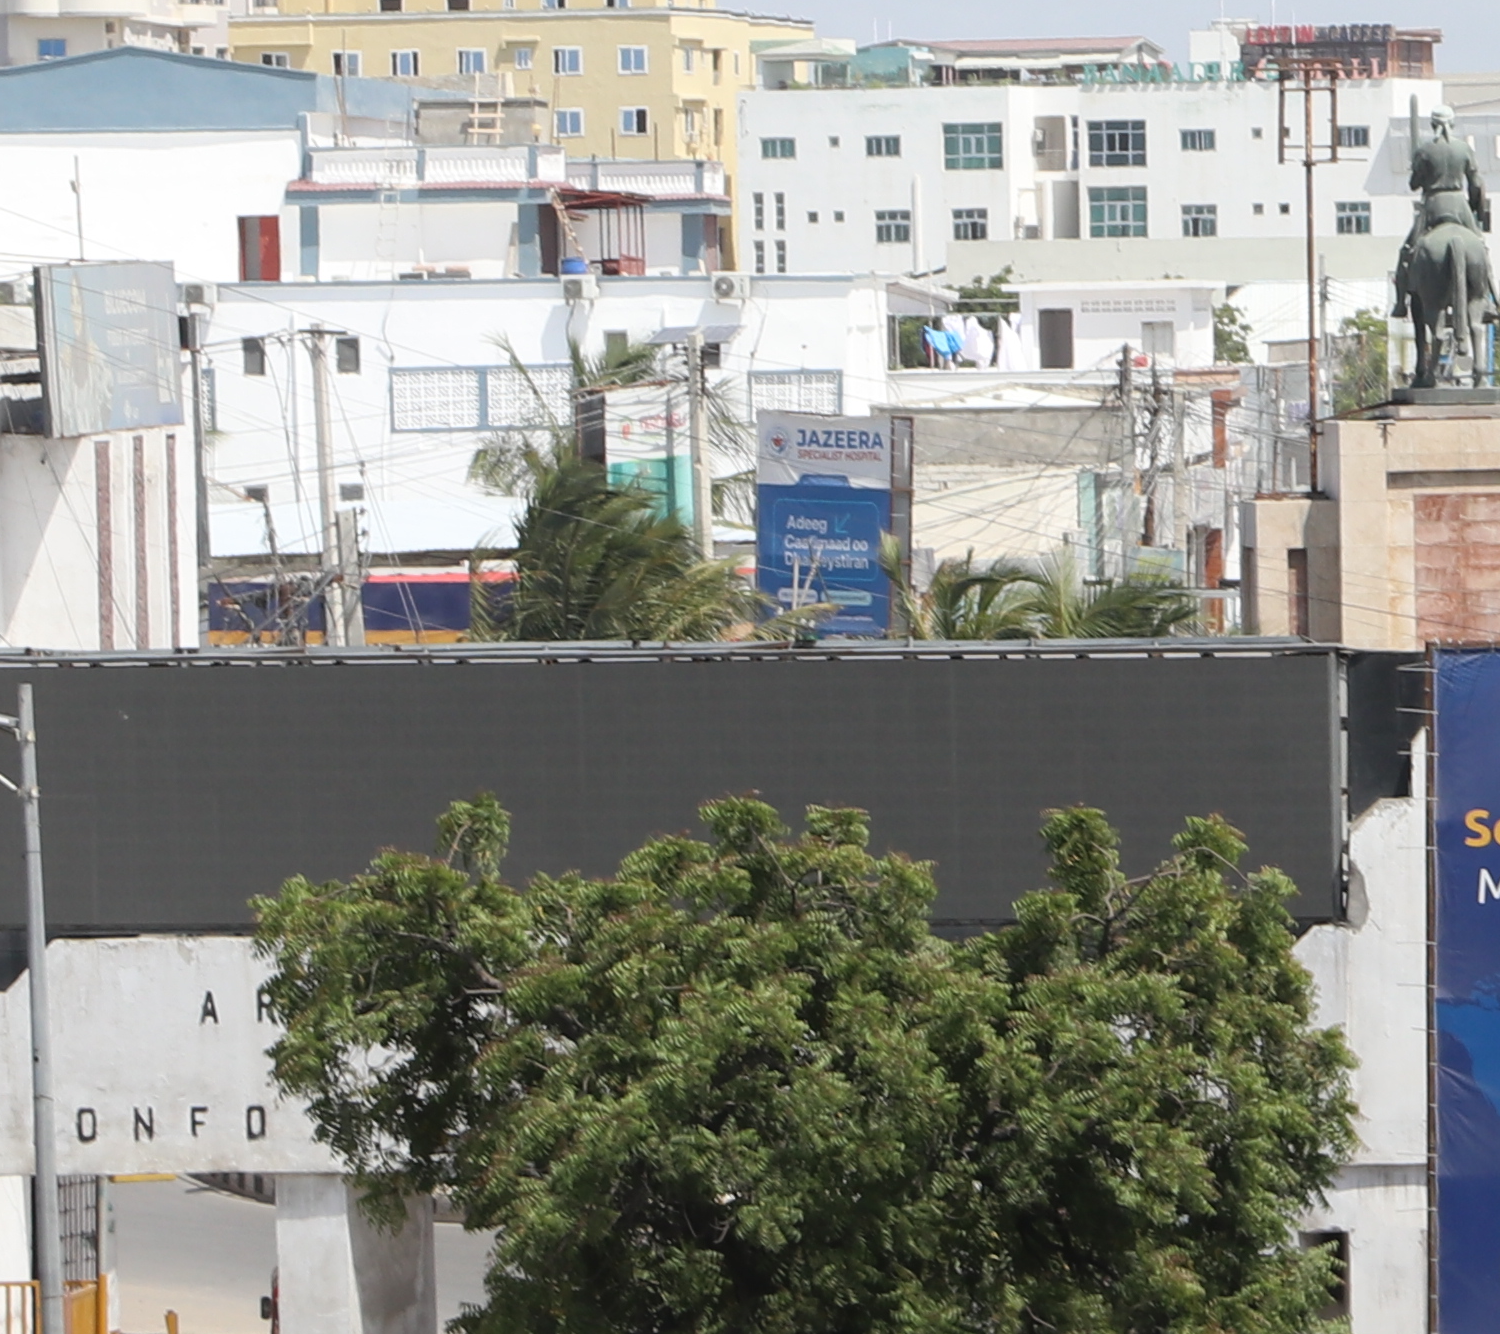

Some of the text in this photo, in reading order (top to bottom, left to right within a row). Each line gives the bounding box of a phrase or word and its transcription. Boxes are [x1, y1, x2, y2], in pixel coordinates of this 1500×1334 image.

[796, 428, 885, 450] JAZEERA
[797, 449, 882, 462] SPECIALIST HOSPITAL
[786, 514, 828, 534] Adeeg
[852, 539, 869, 552] oo
